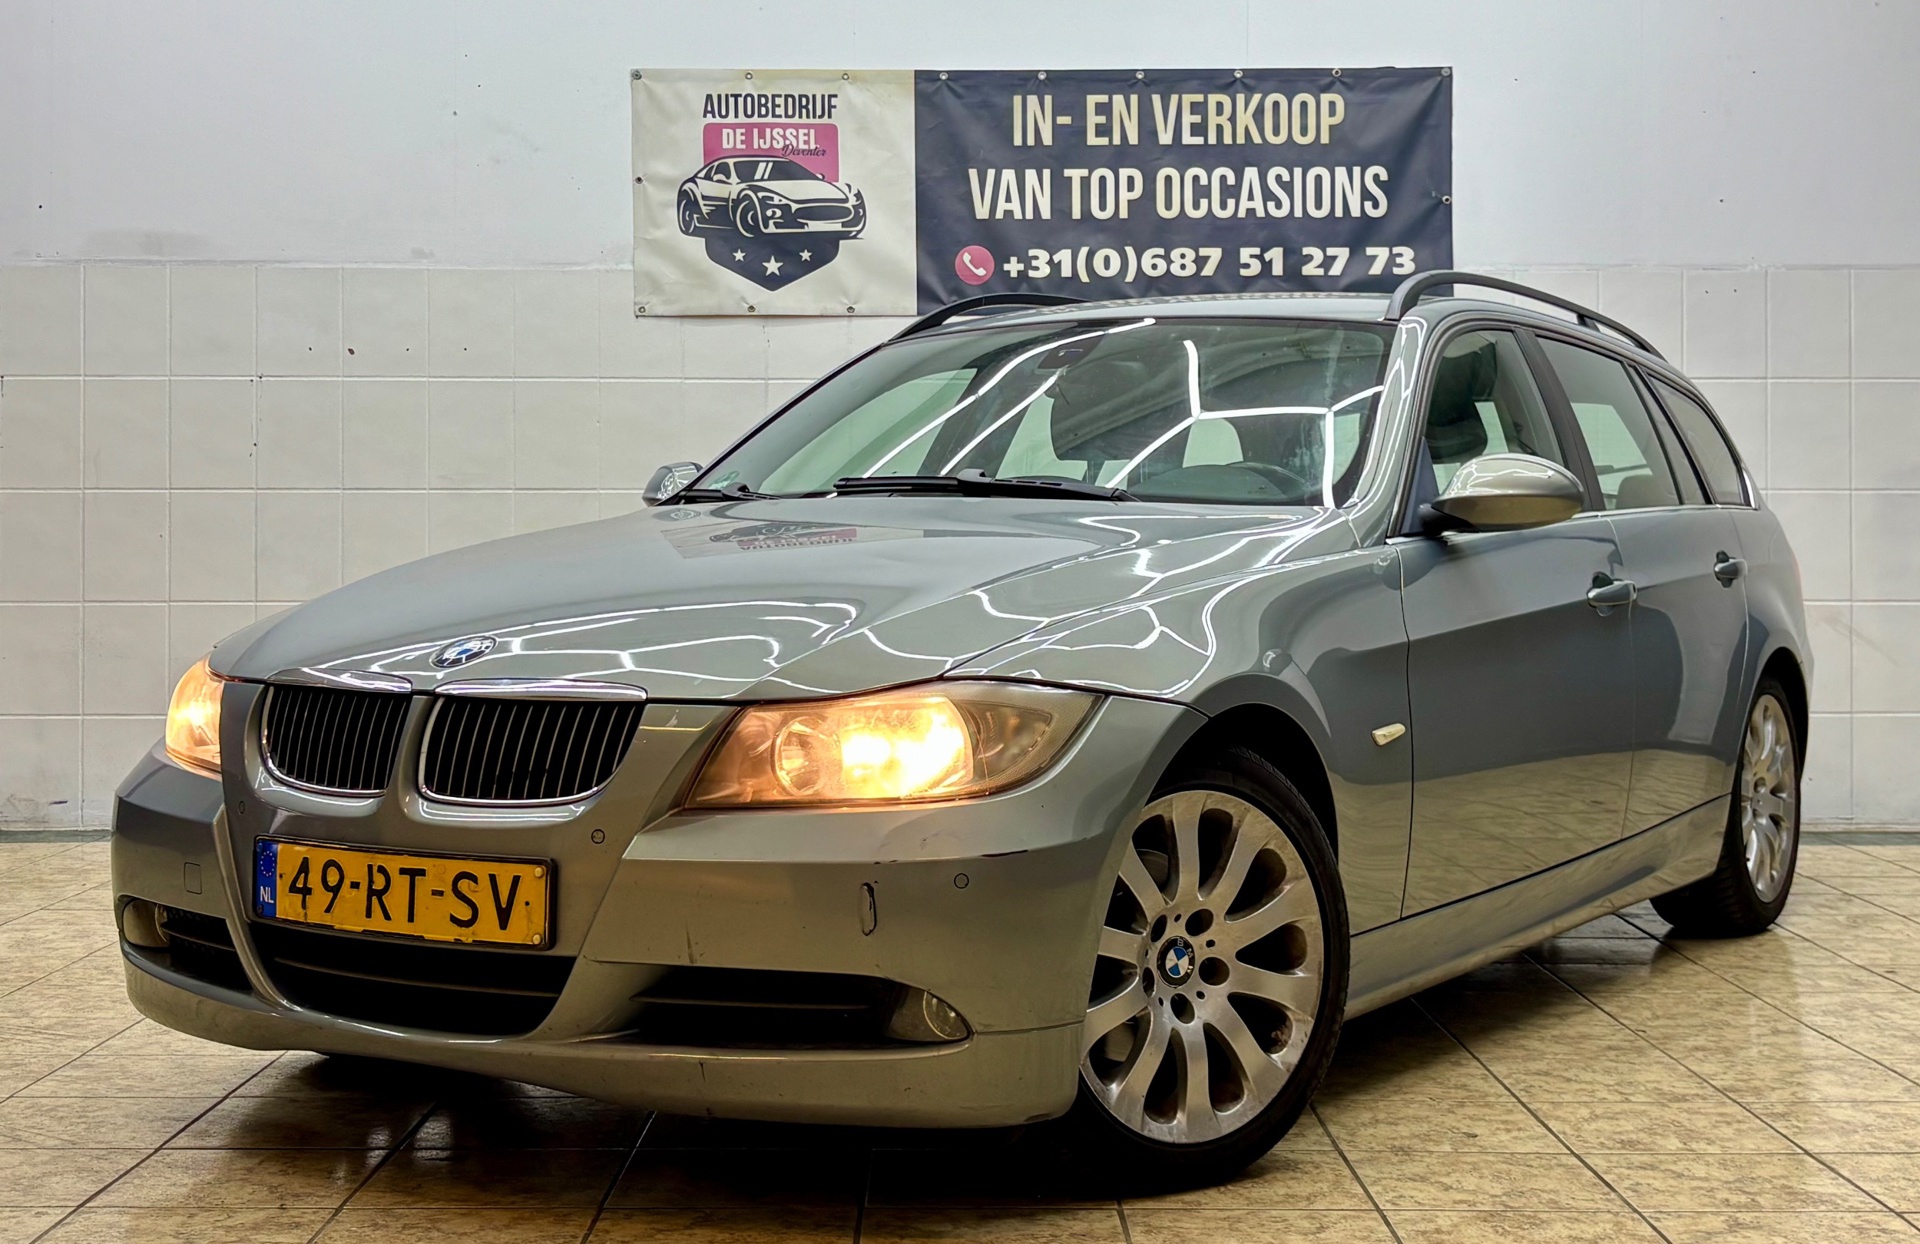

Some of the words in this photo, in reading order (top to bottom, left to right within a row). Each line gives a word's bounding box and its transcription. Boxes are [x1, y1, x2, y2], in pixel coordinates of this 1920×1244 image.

[702, 93, 838, 120] AUTOBEDRIJF
[1012, 94, 1073, 147] IN-
[1085, 93, 1139, 146] EN
[1153, 92, 1346, 145] VERKOOP
[722, 128, 746, 149] DE
[753, 127, 819, 150] IJSSEL
[781, 143, 827, 158] Deventer
[968, 168, 1053, 220] VAN
[1063, 167, 1144, 219] TOP
[1155, 165, 1389, 219] OCCASIONS
[1002, 246, 1223, 283] +31(0)687
[1239, 246, 1284, 276] 51
[1302, 246, 1350, 276] 27
[1365, 246, 1416, 275] 73
[259, 885, 275, 904] NL
[288, 856, 522, 931] 49-RT-SV
